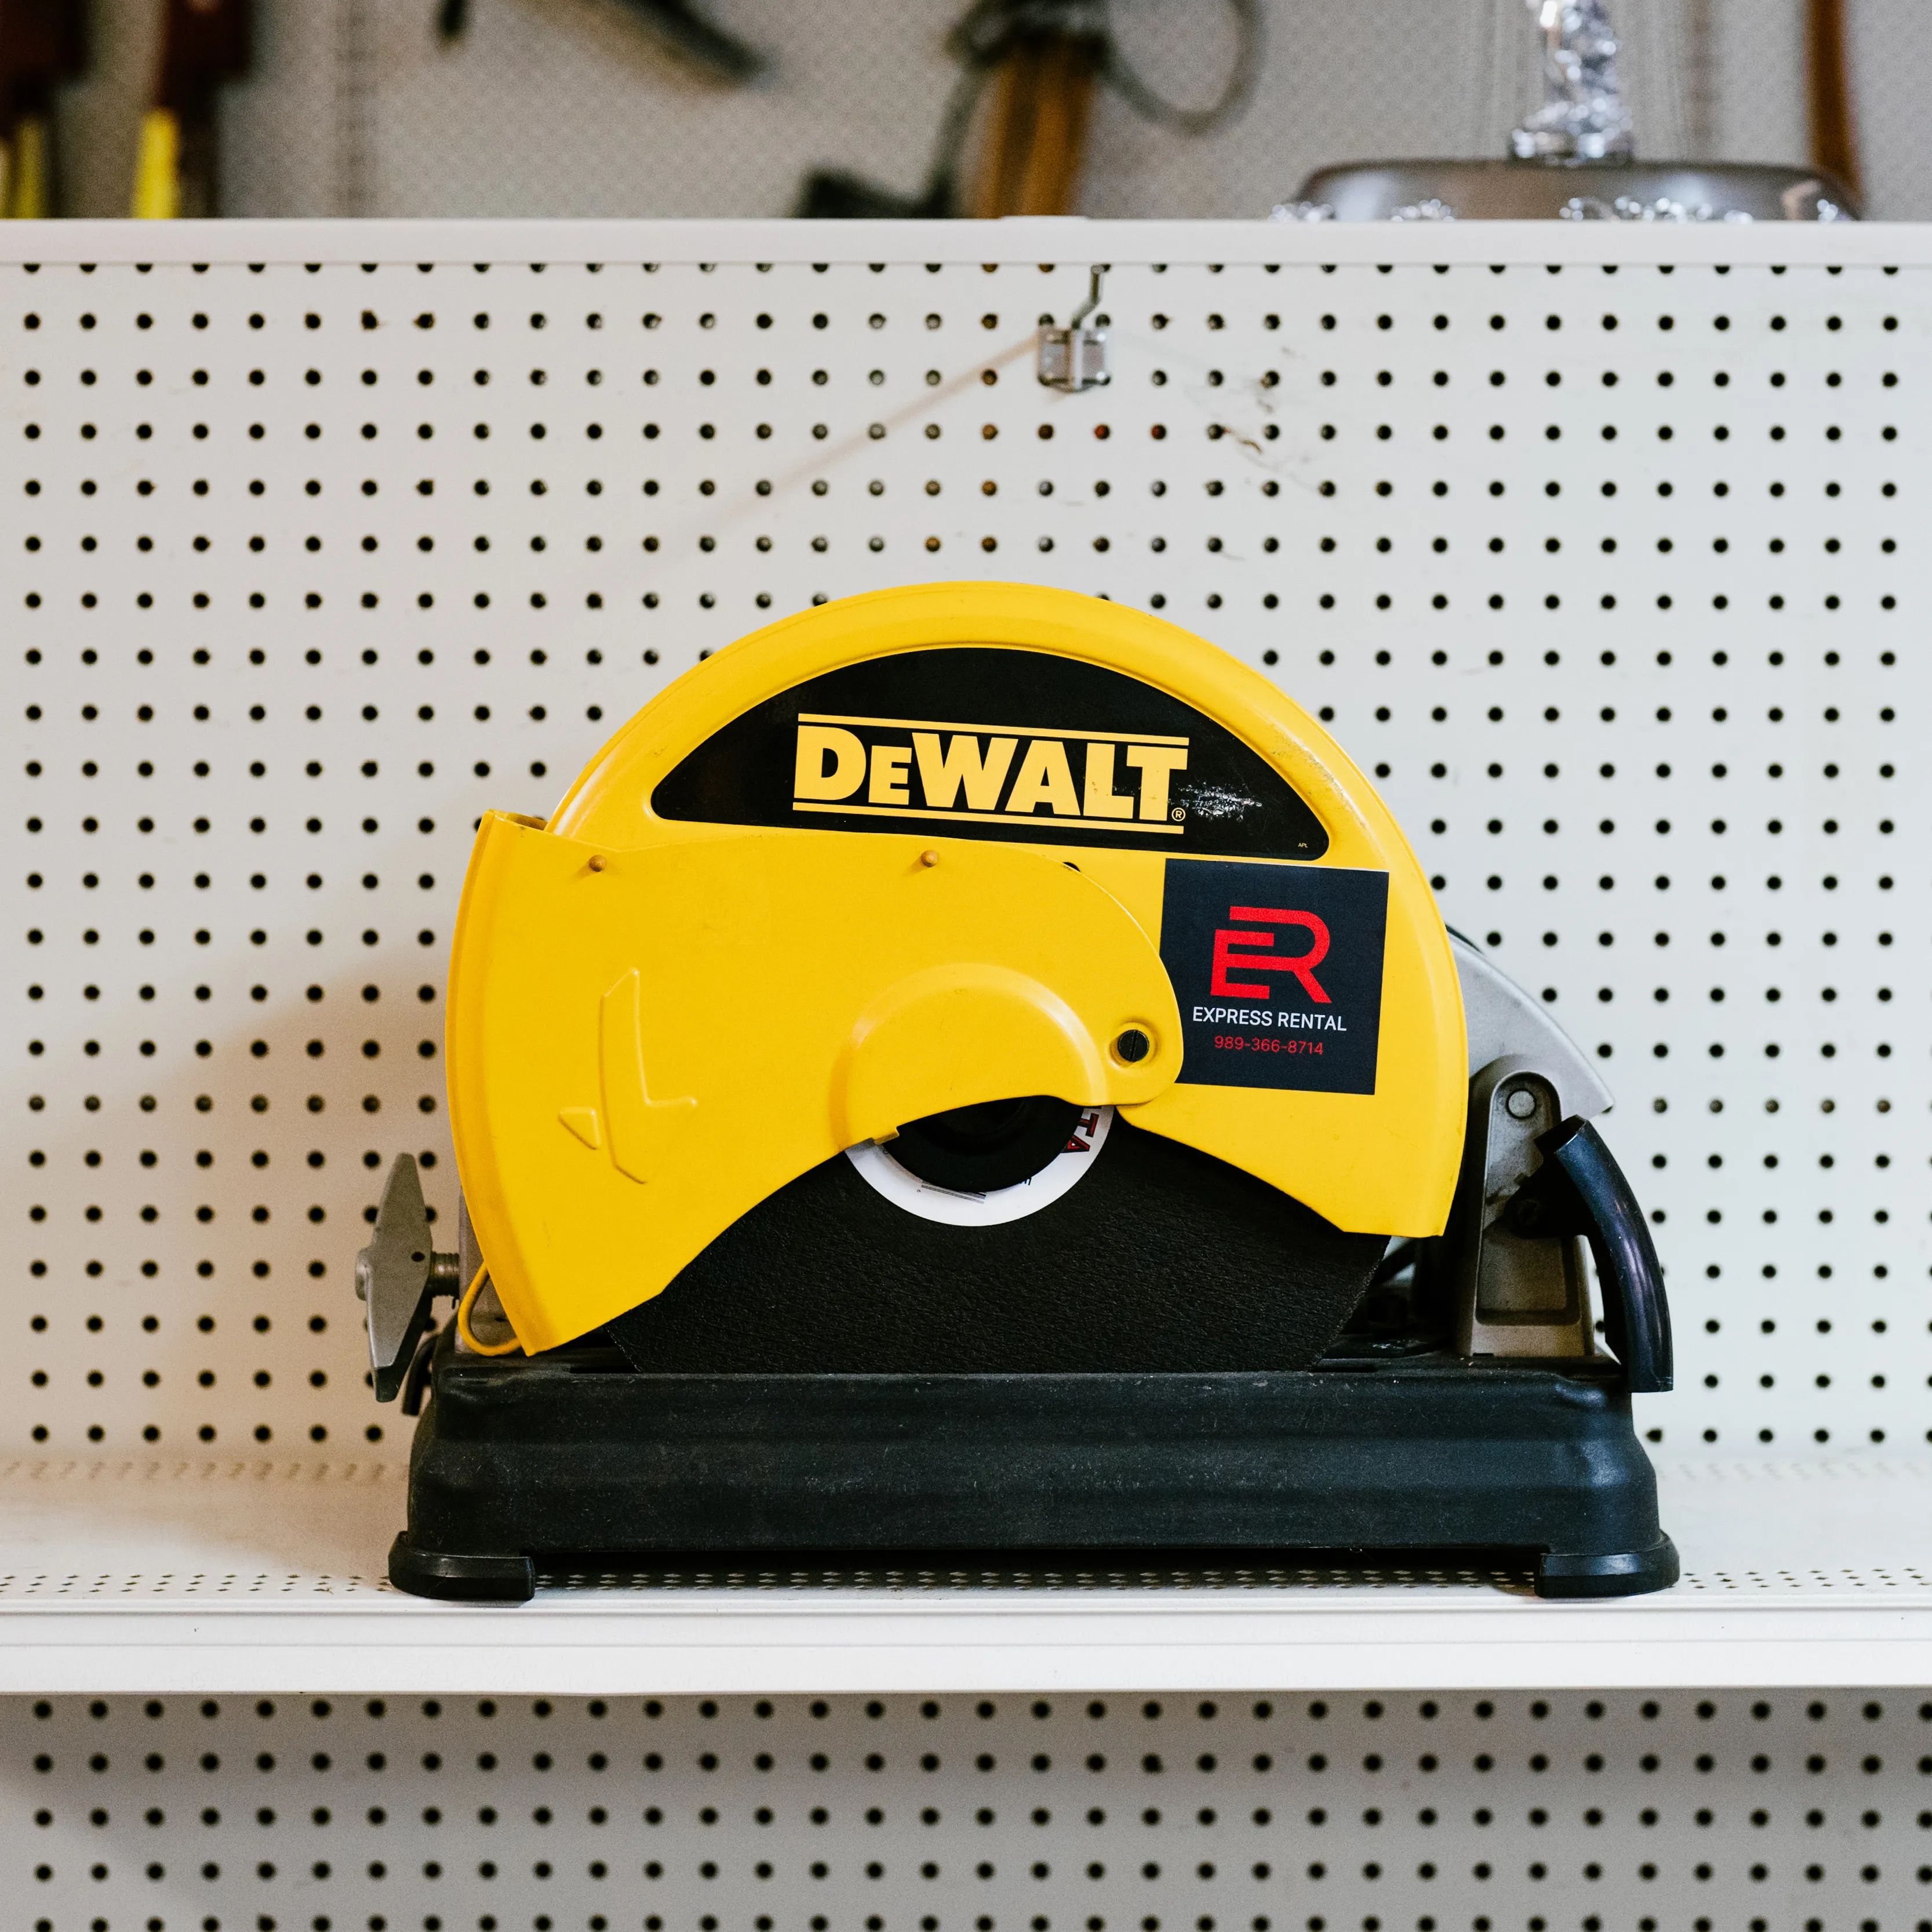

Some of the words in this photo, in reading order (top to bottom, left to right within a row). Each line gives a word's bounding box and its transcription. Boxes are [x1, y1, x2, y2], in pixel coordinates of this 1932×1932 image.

[1210, 906, 1332, 1003] ER
[1192, 1006, 1273, 1027] EXPRESS
[1278, 1012, 1347, 1031] RENTAL
[1214, 1035, 1323, 1055] 989-366-8714
[1060, 1106, 1102, 1154] TA
